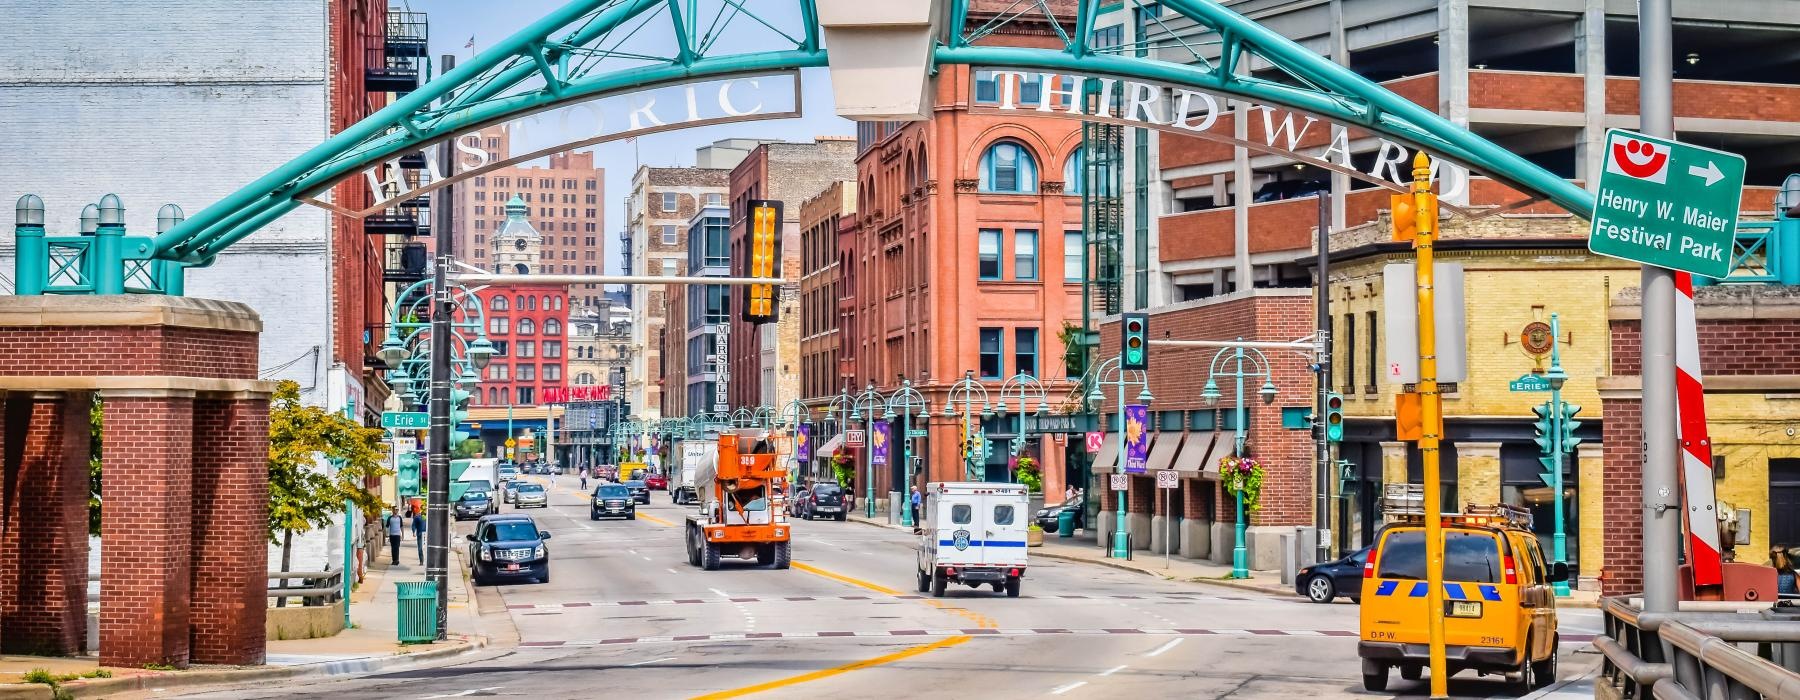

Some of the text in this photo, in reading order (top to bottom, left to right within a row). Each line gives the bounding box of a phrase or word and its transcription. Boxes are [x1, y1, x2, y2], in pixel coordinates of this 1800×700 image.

[363, 77, 763, 206] HISTORIC
[991, 70, 1466, 201] THIRD WARD
[1600, 188, 1729, 232] Henry W. Maier
[1595, 217, 1724, 262] Festival Park
[717, 325, 727, 402] MARSHALL
[1516, 382, 1541, 390] ERIE
[395, 414, 414, 425] Erie
[1480, 636, 1505, 645] 23161
